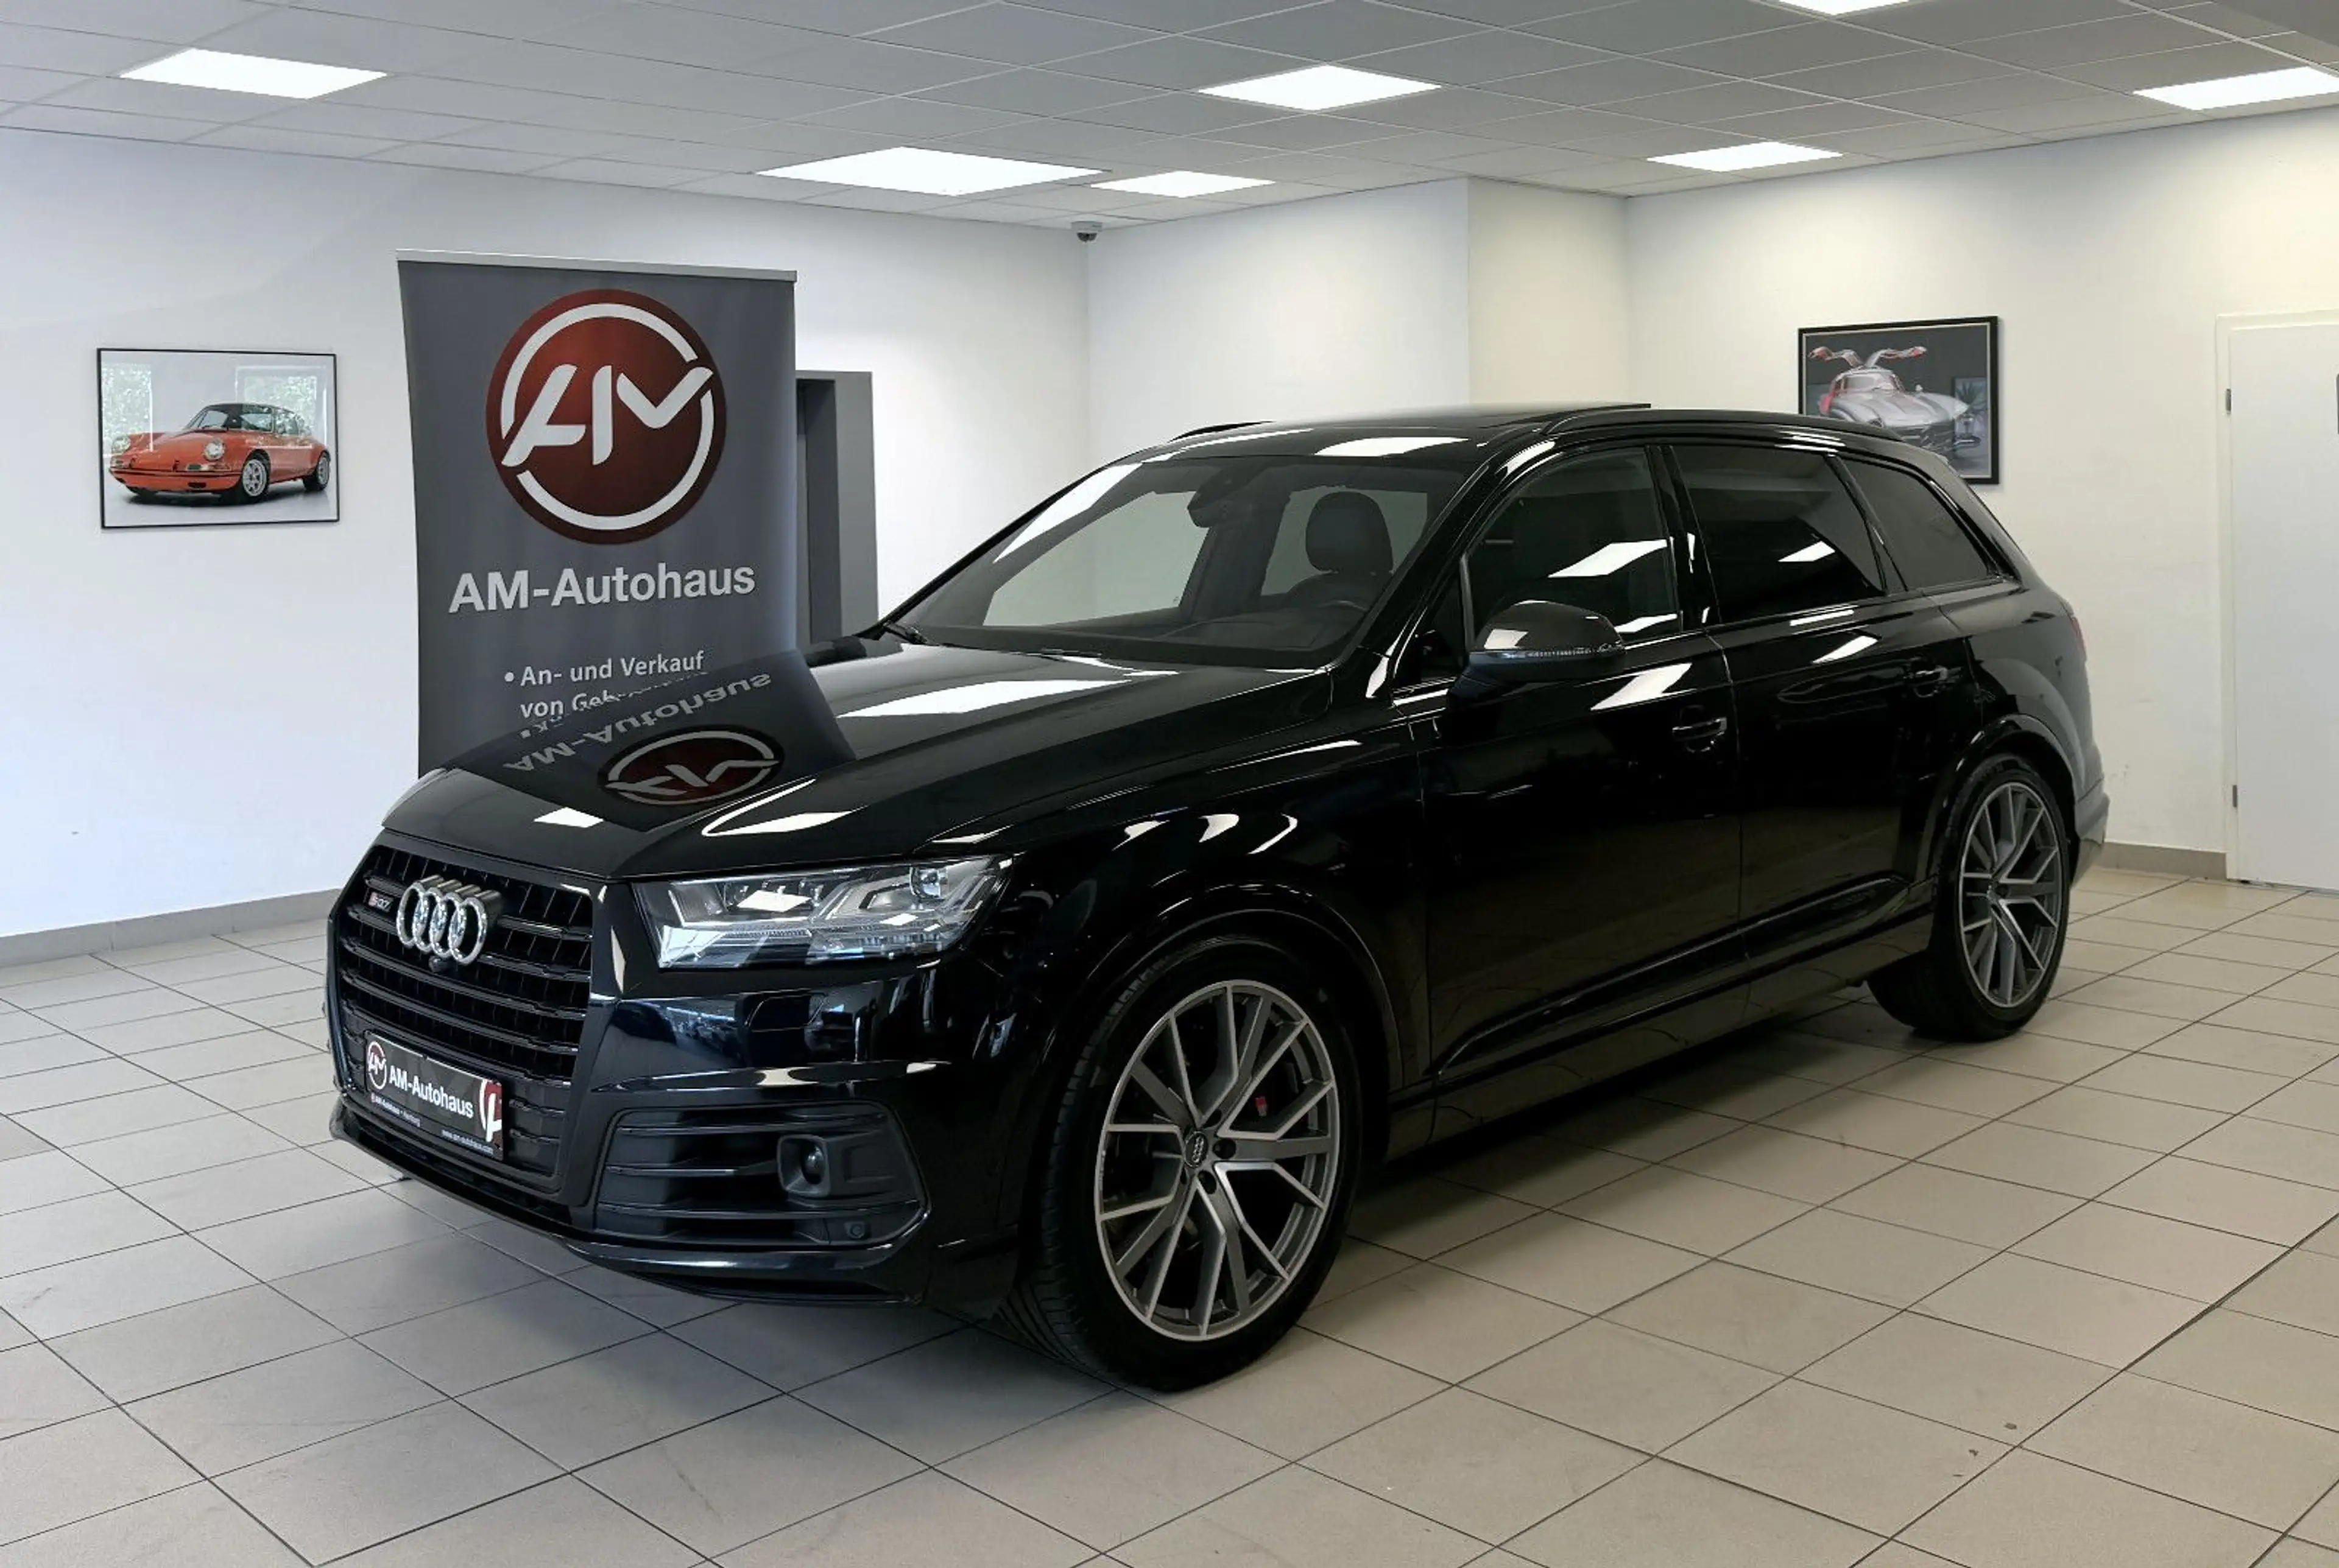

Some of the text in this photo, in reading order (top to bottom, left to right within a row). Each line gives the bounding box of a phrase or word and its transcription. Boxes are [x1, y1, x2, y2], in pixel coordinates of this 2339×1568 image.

[448, 563, 755, 613] AM-Autohaus
[520, 650, 704, 686] An- und Verkauf
[520, 700, 564, 719] von
[389, 1065, 475, 1119] AM-Autohaus
